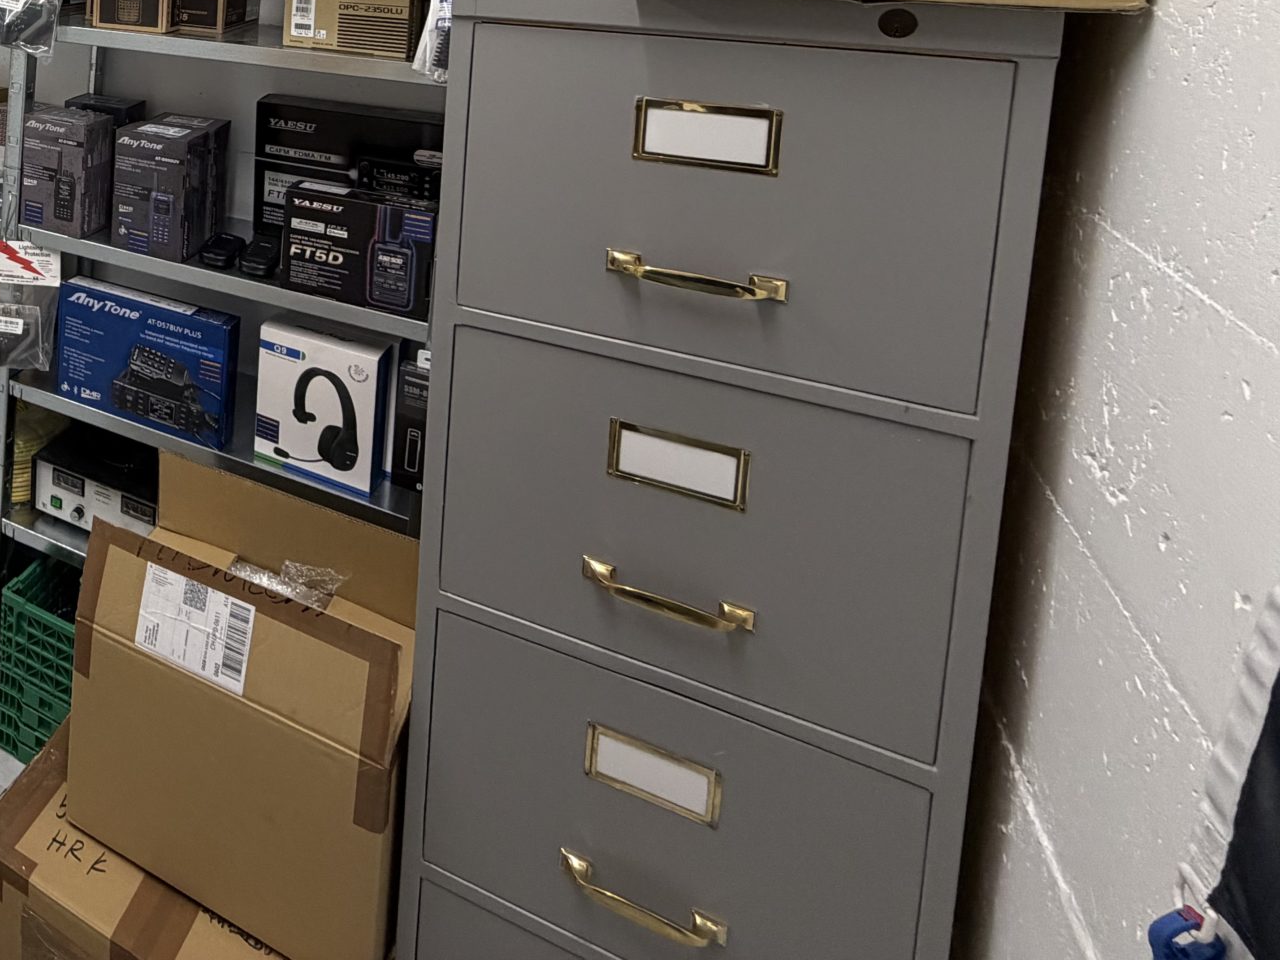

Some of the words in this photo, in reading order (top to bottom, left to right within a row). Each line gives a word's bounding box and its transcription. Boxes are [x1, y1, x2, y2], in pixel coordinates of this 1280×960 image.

[338, 3, 403, 15] OPC-2350LU
[25, 119, 66, 135] AnyTone
[269, 118, 317, 132] YAESU
[118, 136, 163, 151] AnyTone
[293, 150, 316, 159] FDMA
[292, 198, 344, 213] YAESU
[289, 245, 344, 265] FT5D
[67, 292, 140, 321] AnyTone
[183, 327, 202, 339] PLUS
[273, 344, 287, 355] Q9
[46, 829, 108, 876] HRK
